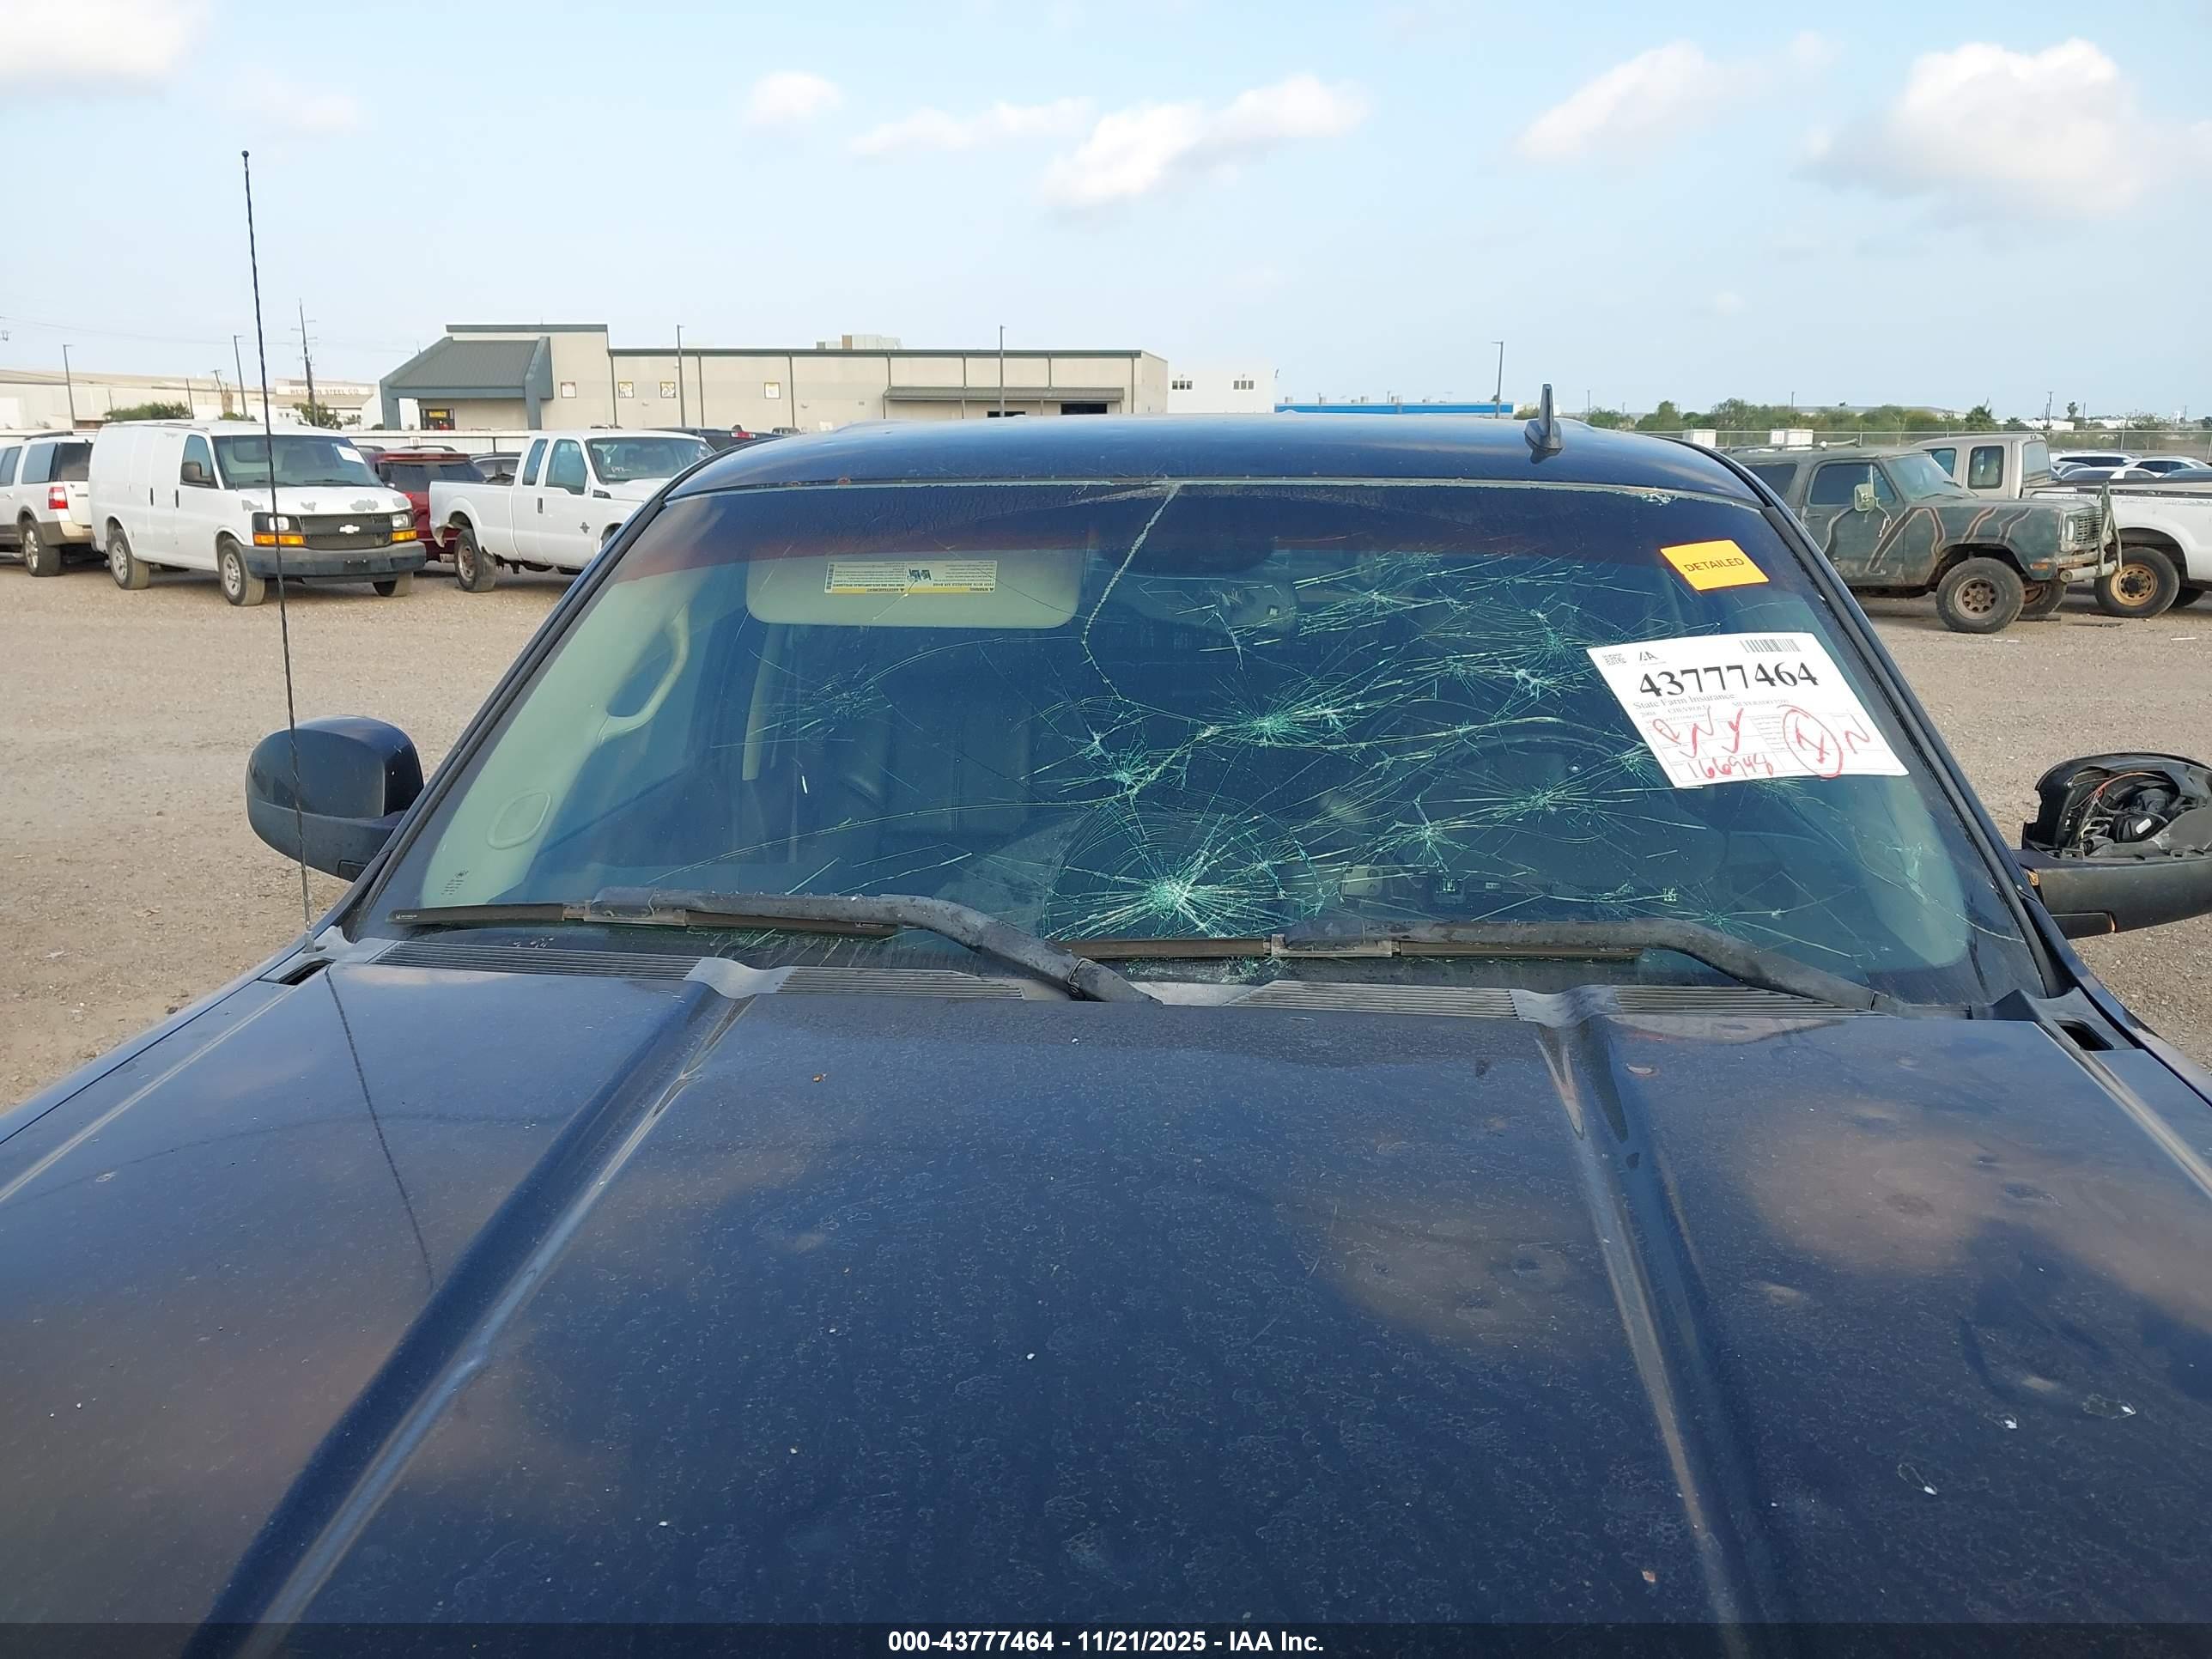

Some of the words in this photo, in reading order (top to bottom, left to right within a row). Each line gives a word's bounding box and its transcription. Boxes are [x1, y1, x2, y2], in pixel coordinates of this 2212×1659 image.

[1683, 556, 1745, 573] DETAILED
[1639, 661, 1820, 697] 43777464
[1632, 701, 1661, 710] State
[1661, 697, 1688, 706] Farm
[1688, 693, 1735, 703] Insurance
